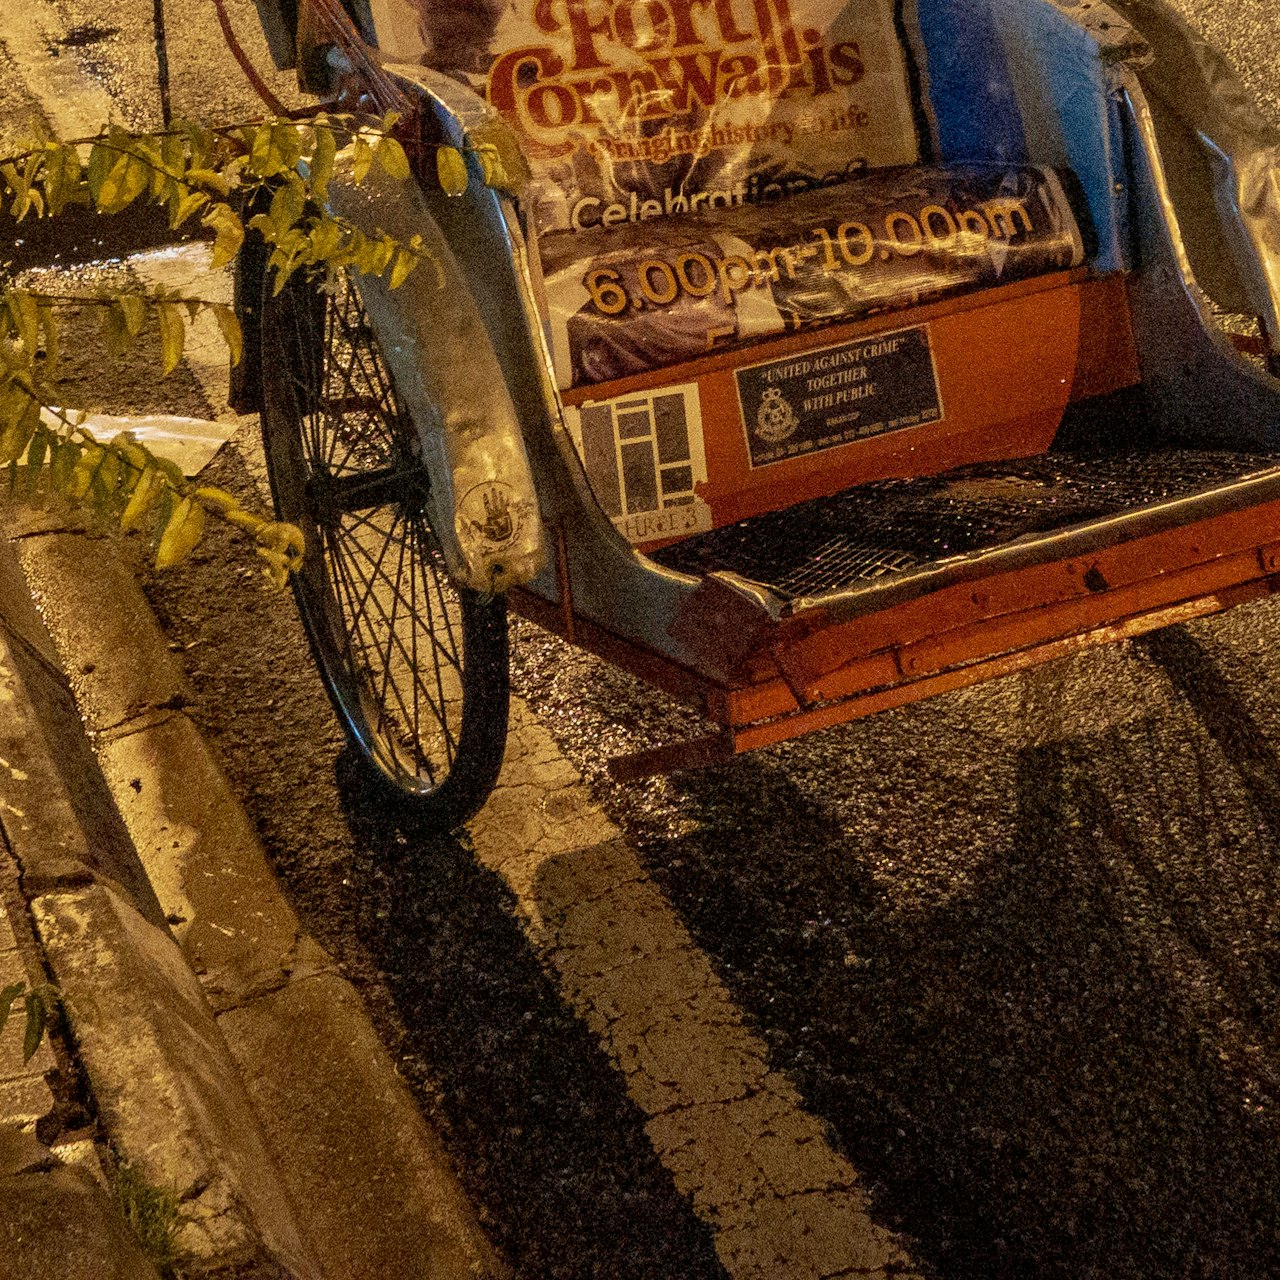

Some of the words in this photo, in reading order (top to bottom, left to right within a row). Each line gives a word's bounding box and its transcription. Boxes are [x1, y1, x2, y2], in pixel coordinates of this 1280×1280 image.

[711, 120, 795, 147] history
[830, 104, 869, 131] life
[813, 347, 861, 370] AGAINST
[807, 366, 868, 392] TOGETHER
[803, 393, 834, 413] WITH
[836, 382, 876, 406] PUBLIC
